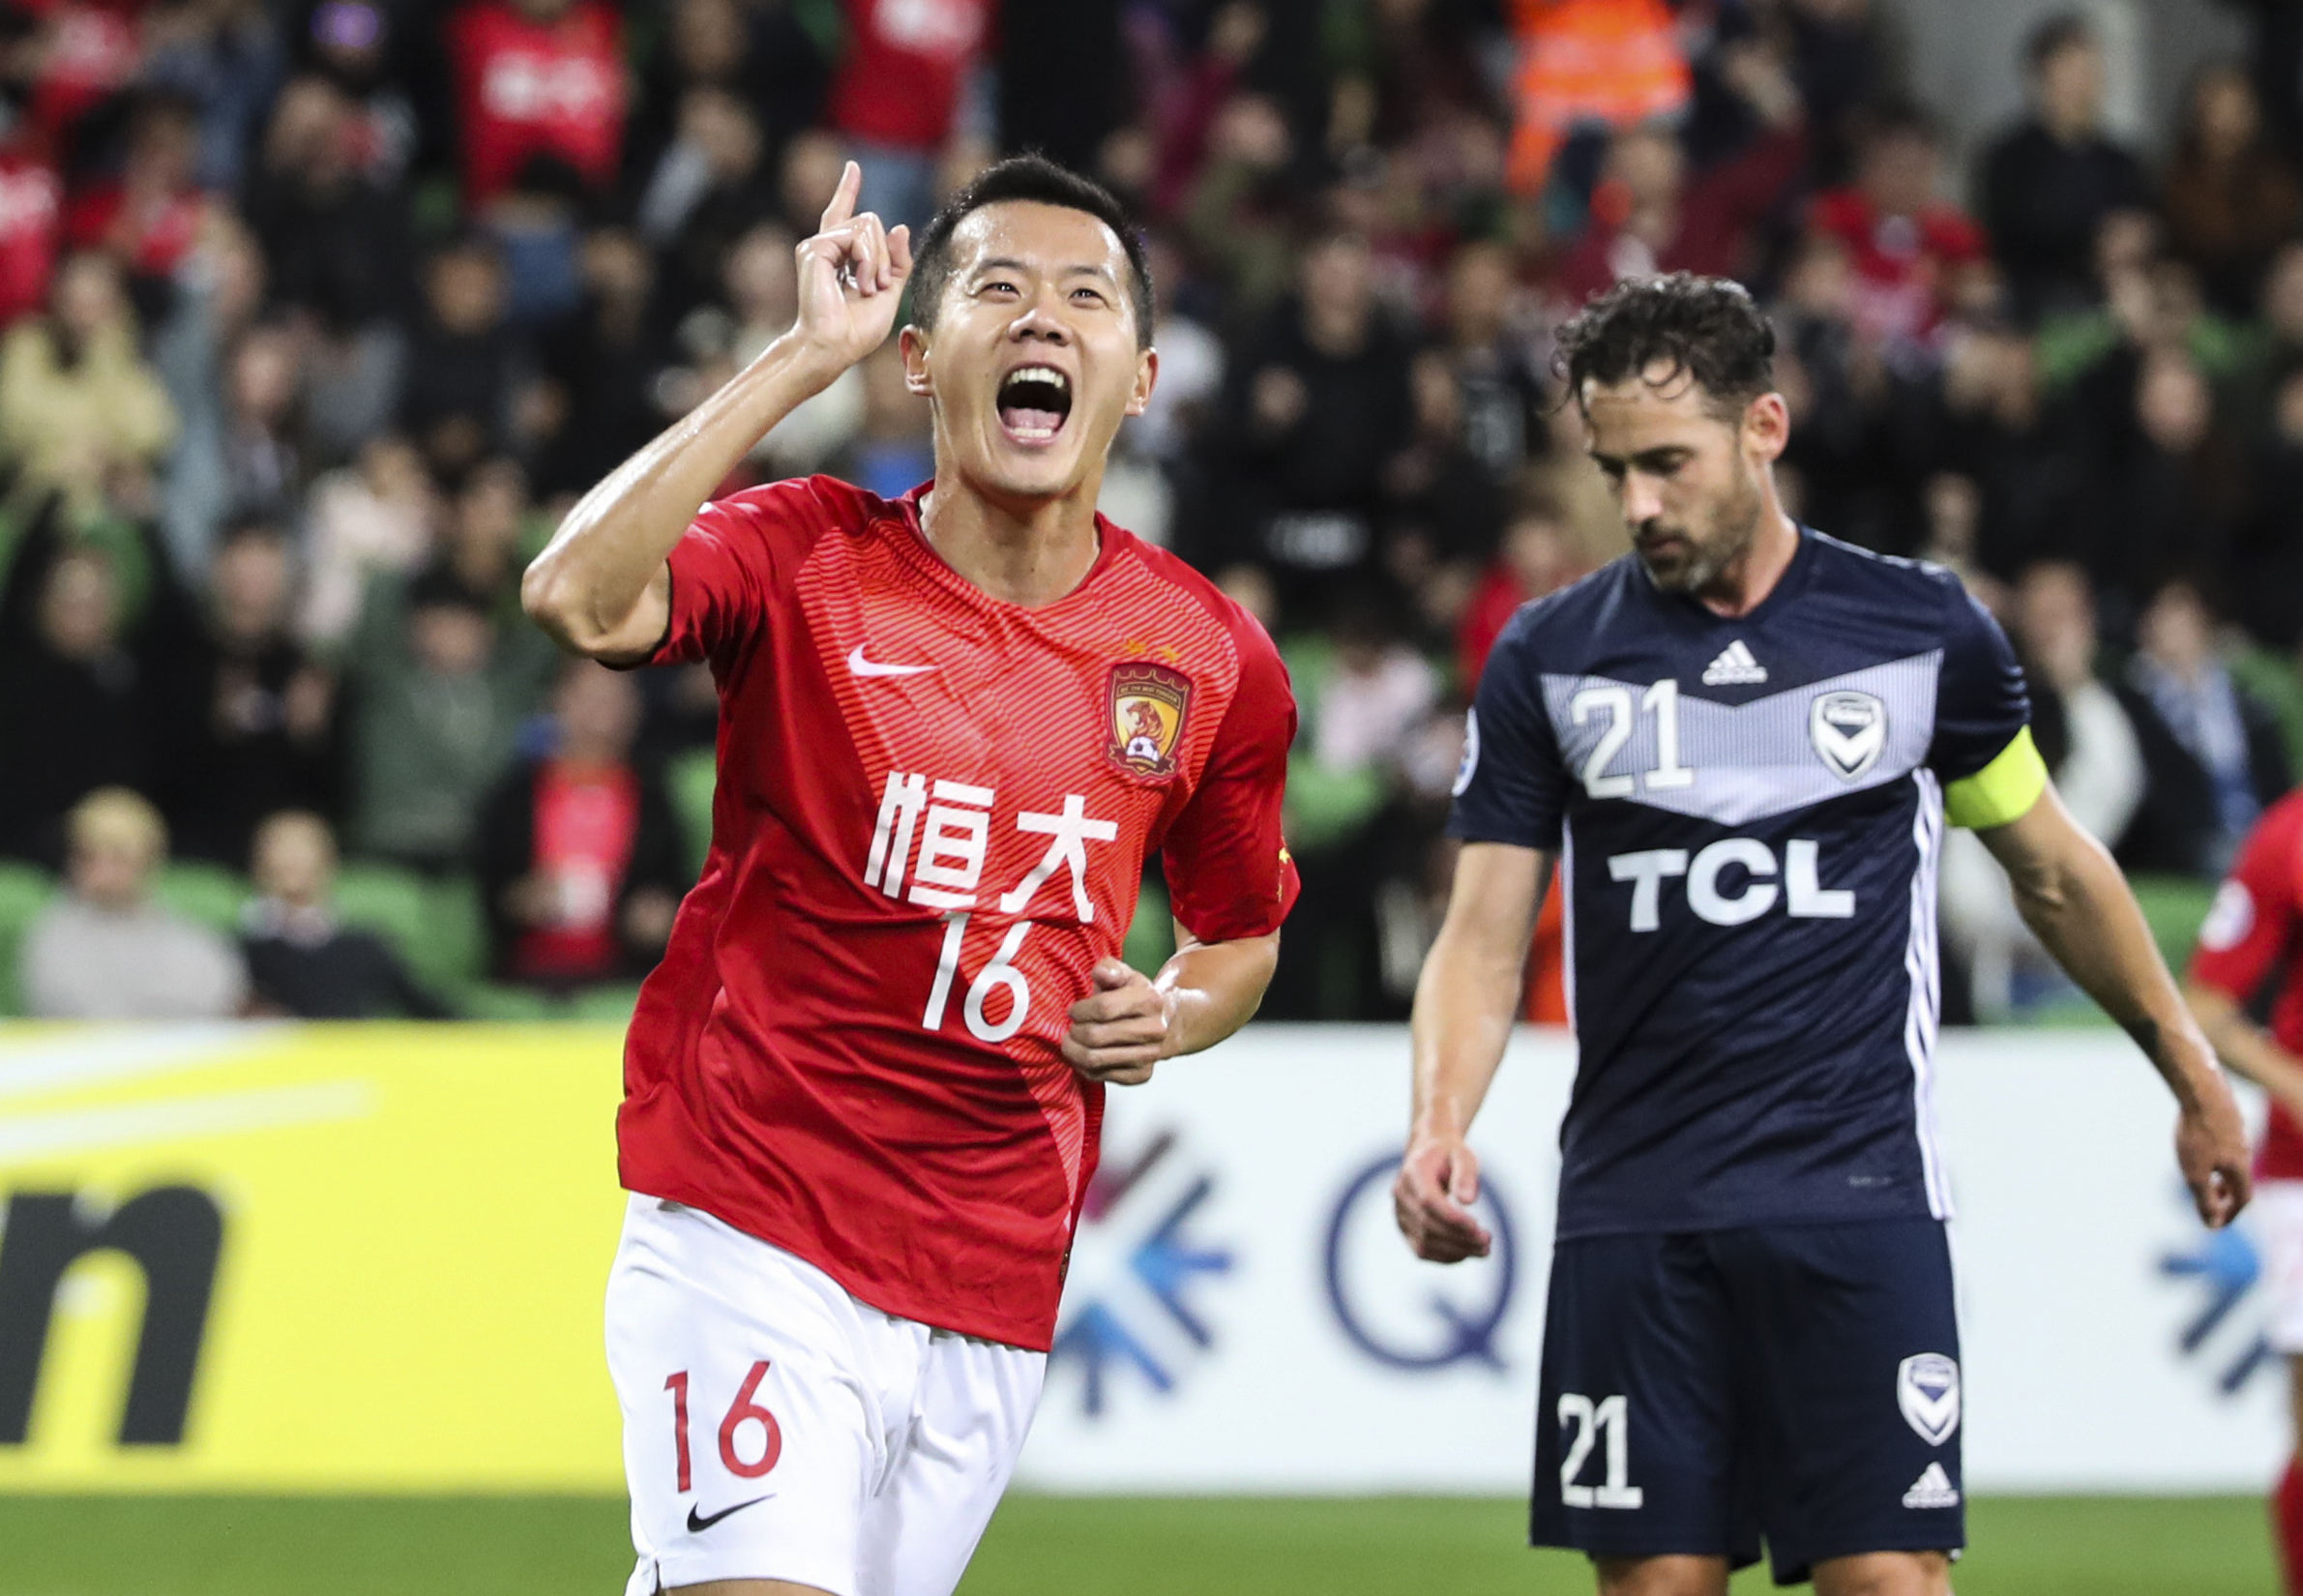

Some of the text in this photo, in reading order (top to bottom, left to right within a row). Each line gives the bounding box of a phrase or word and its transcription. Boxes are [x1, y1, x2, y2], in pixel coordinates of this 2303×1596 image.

[1571, 679, 1694, 799] 21
[864, 769, 1118, 924] 恒大
[1607, 838, 1856, 932] TCL
[922, 910, 1030, 1043] 16
[664, 1360, 782, 1493] 16
[1557, 1393, 1642, 1509] 21
